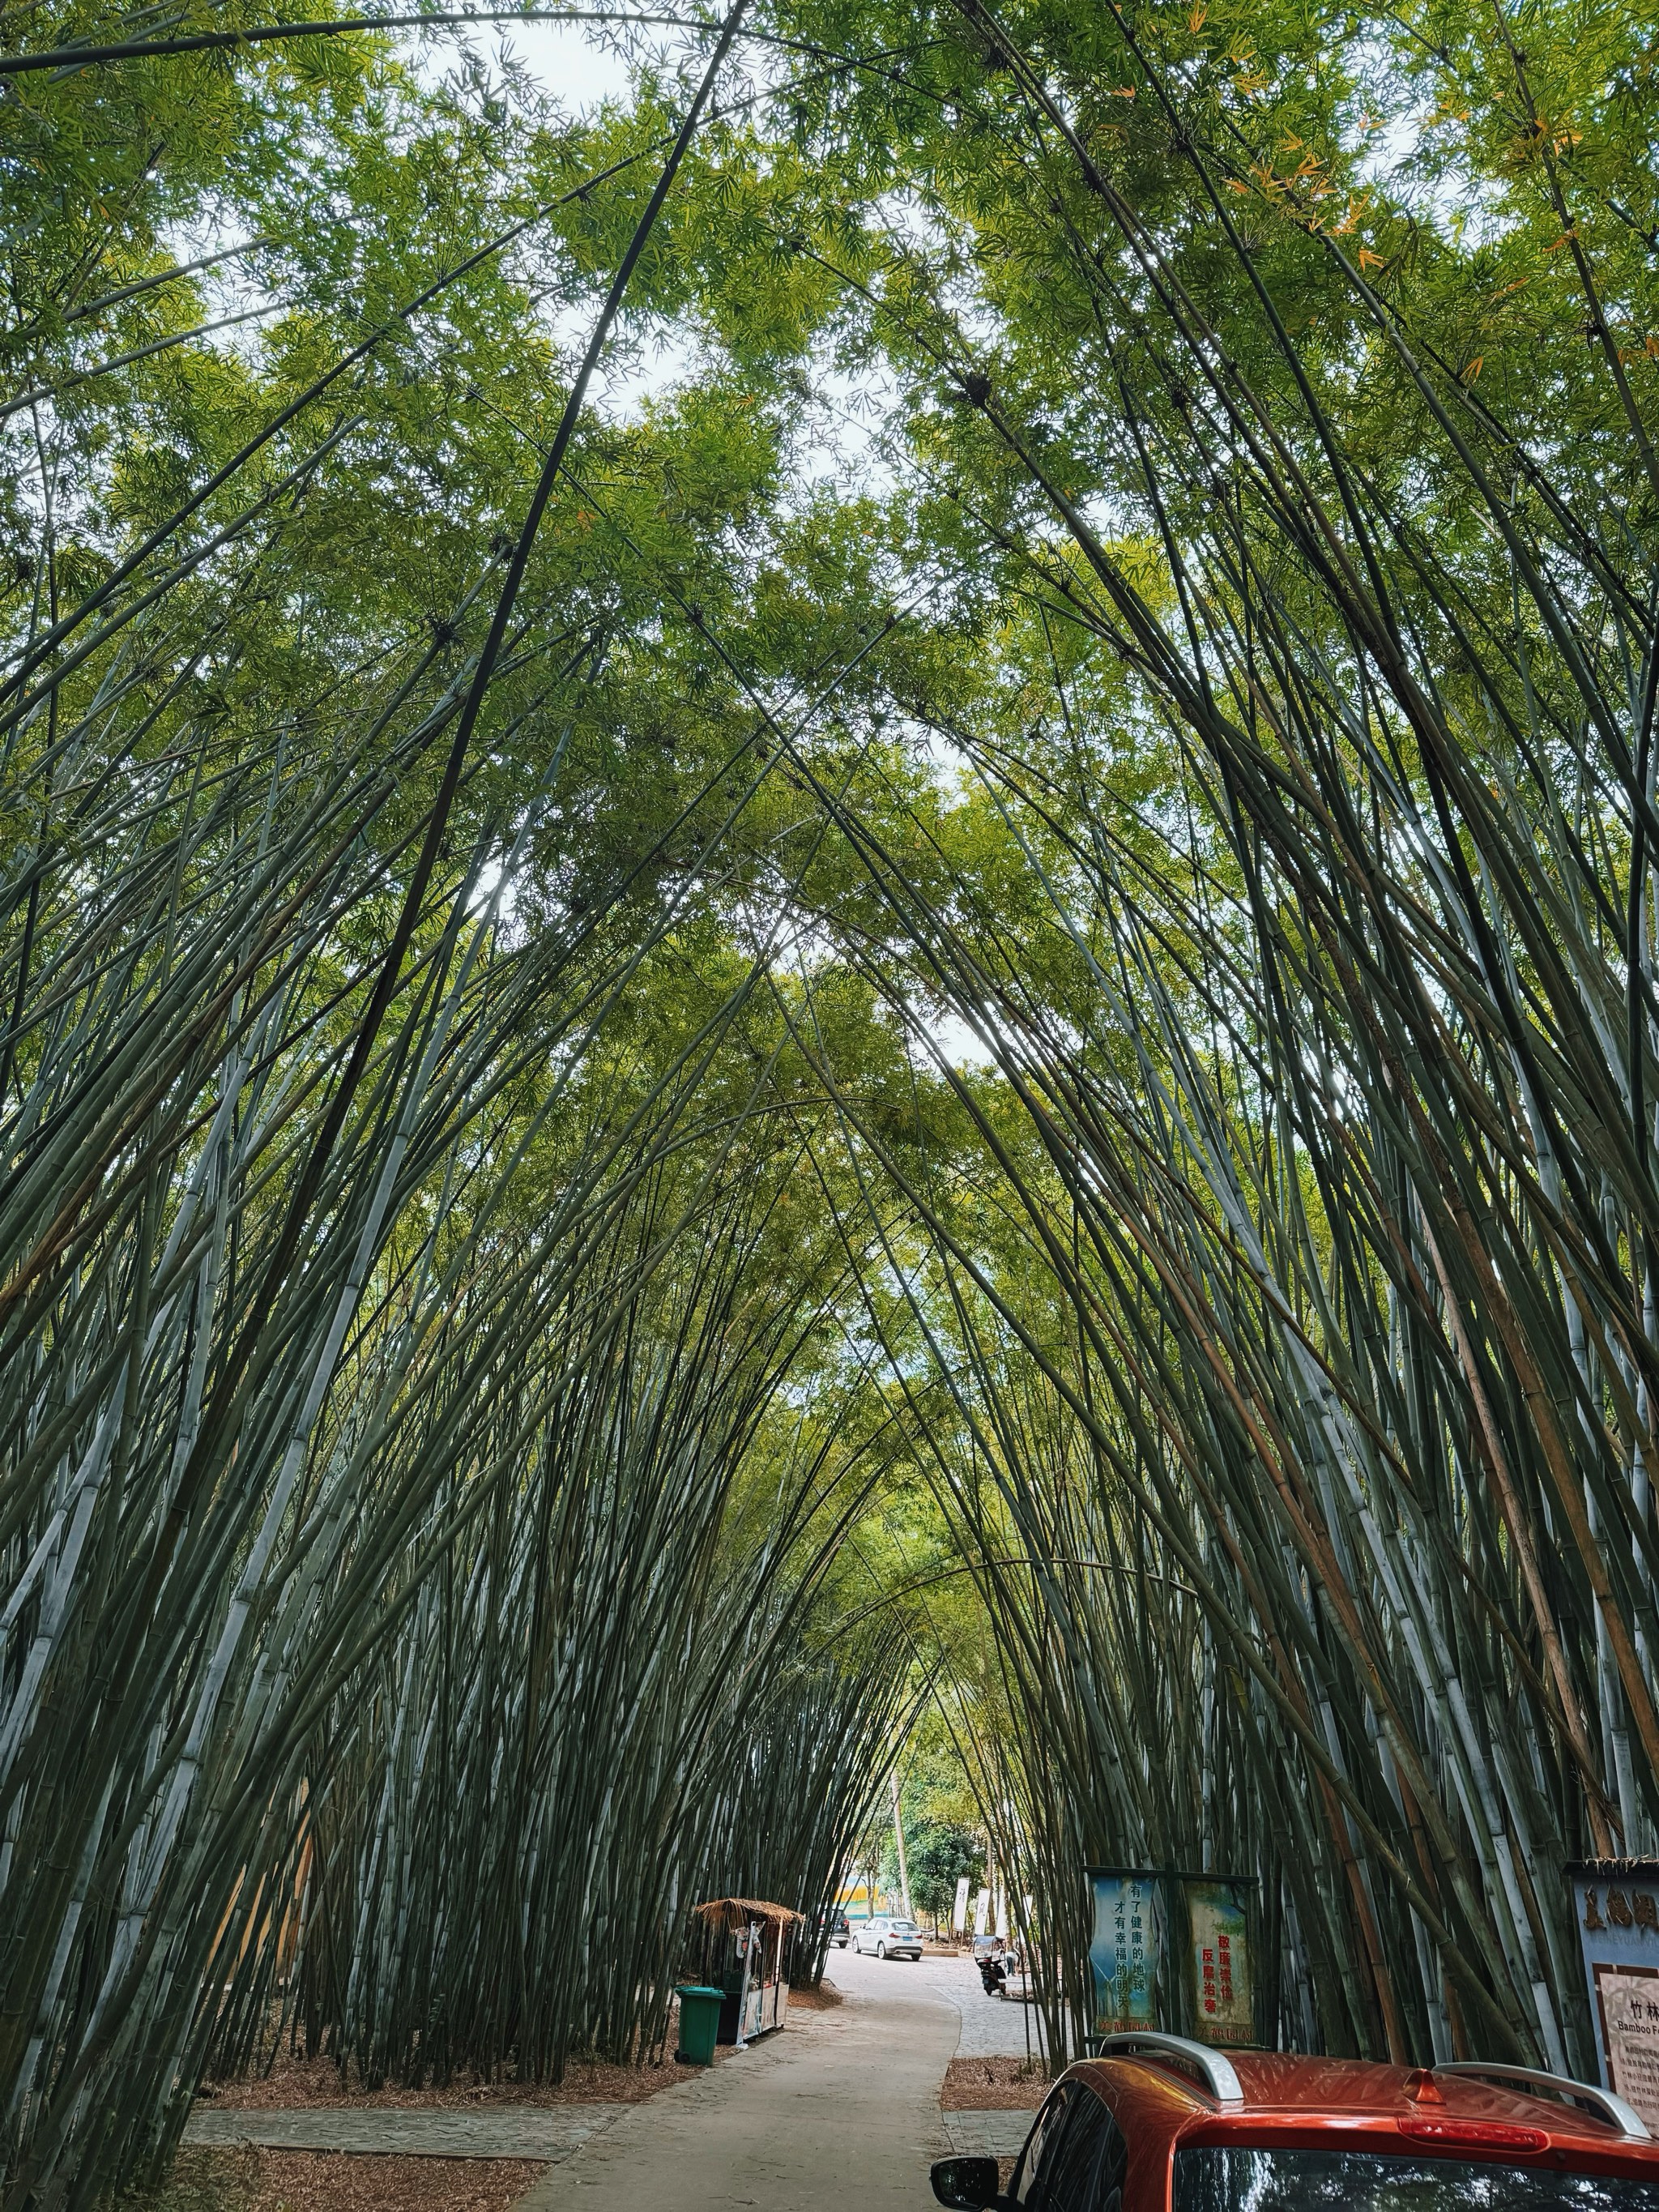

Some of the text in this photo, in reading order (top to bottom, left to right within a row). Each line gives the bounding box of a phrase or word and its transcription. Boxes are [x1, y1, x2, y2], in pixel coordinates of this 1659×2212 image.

[1114, 1901, 1129, 2009] 才有幸福的明天
[1129, 1884, 1146, 1993] 有了健康的地球
[1618, 2020, 1651, 2035] Bamboo
[1631, 2000, 1659, 2022] 竹林
